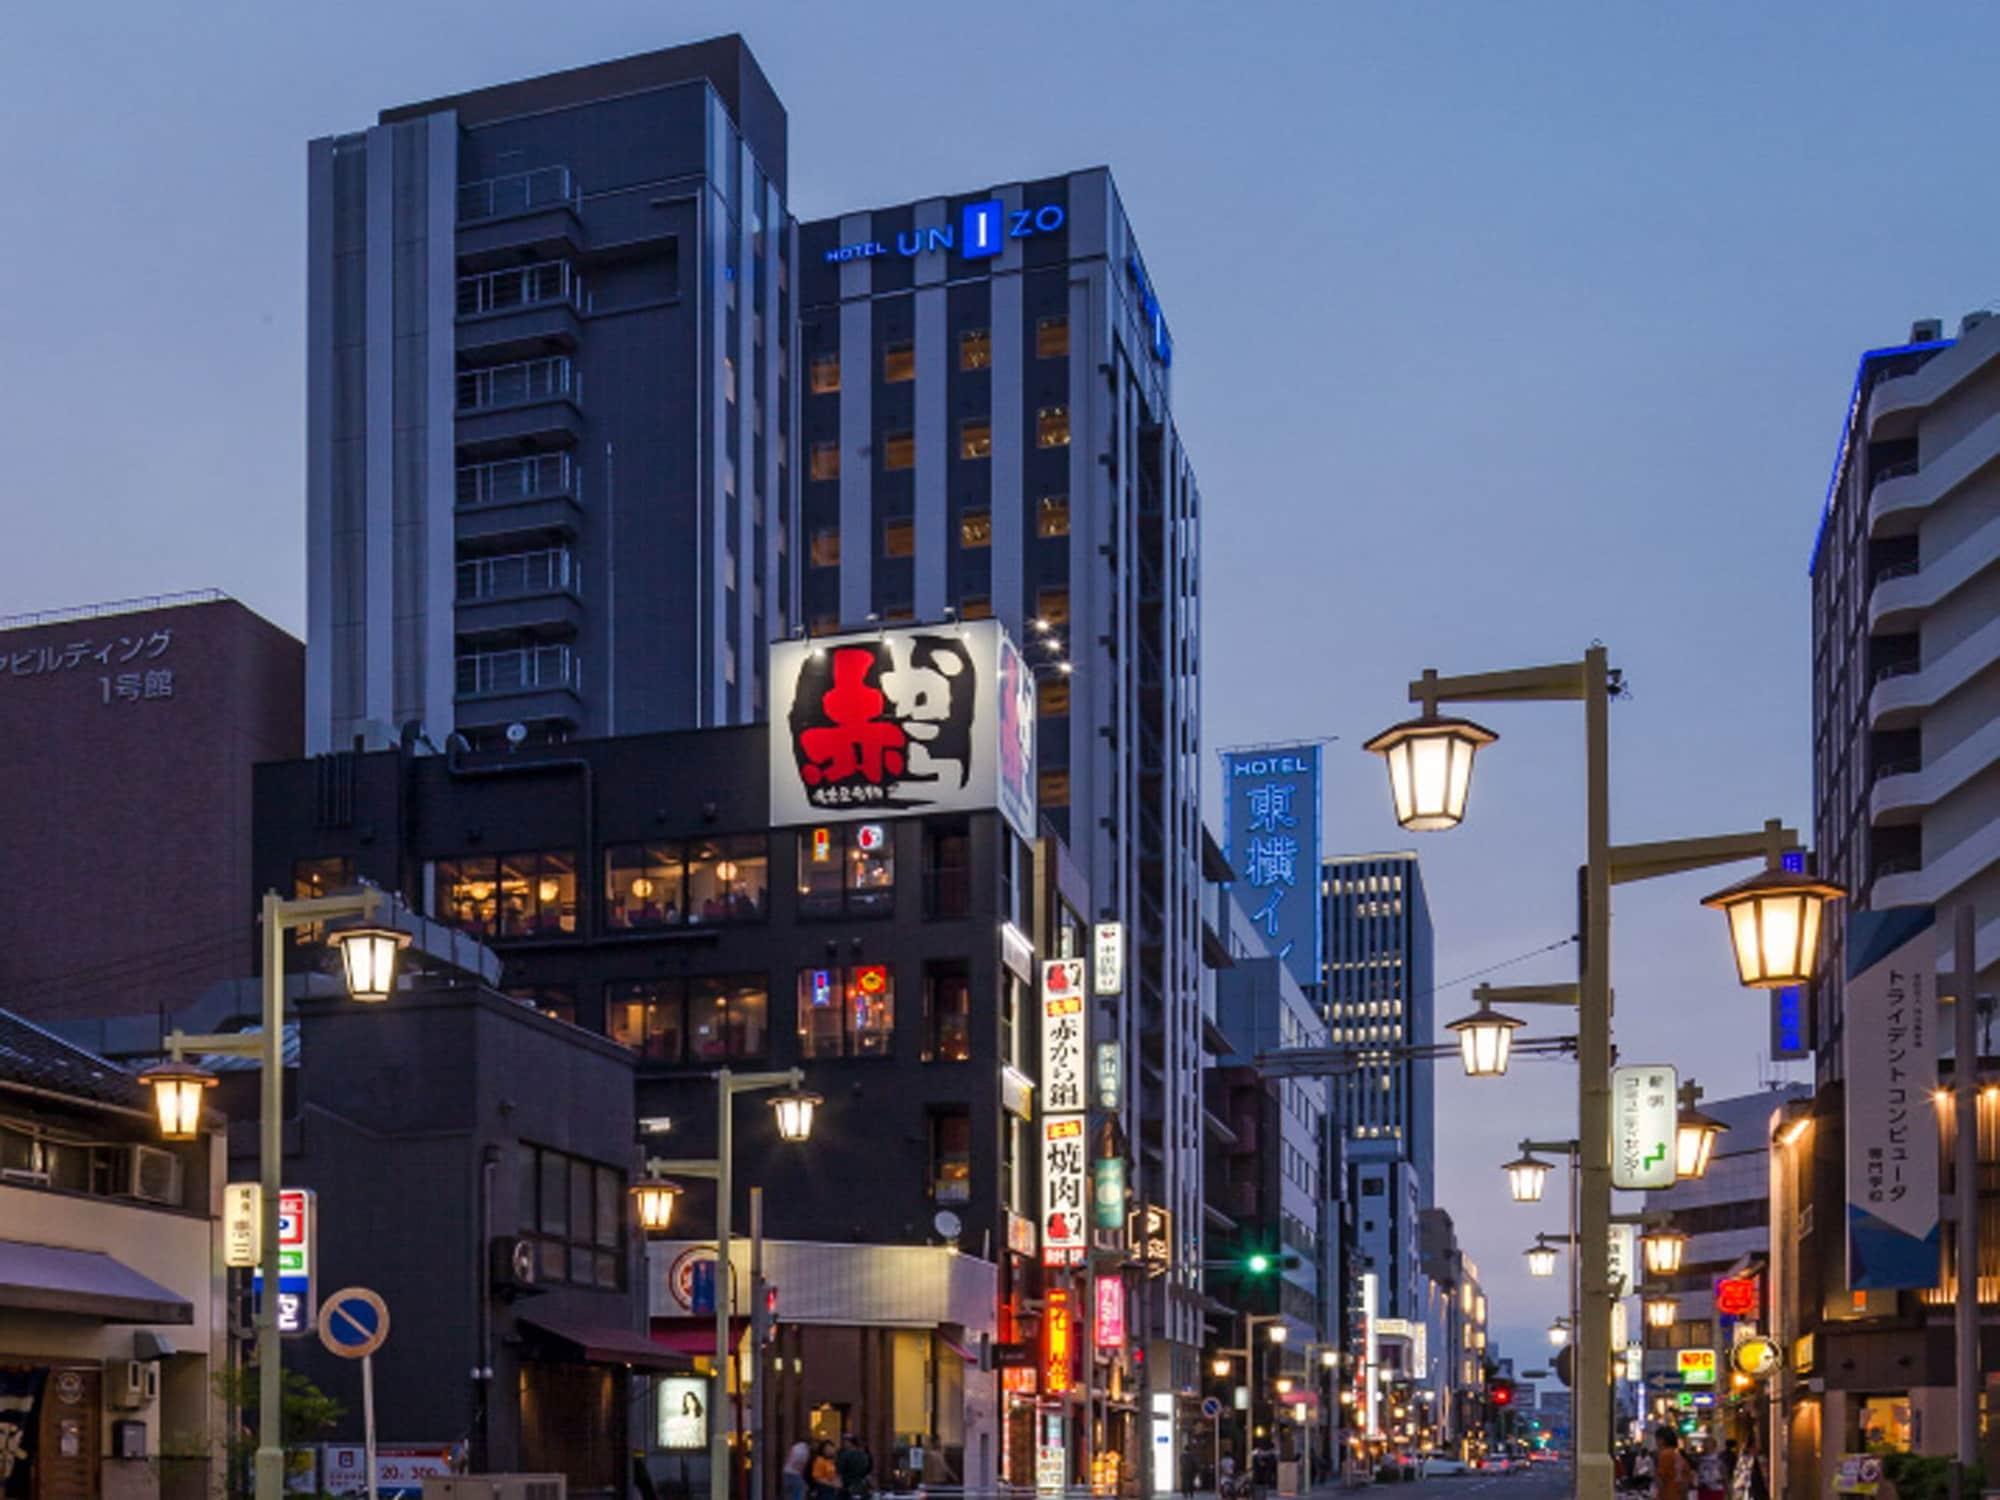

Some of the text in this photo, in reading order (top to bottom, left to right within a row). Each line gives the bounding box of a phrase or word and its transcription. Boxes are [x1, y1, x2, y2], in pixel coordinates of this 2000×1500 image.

[825, 200, 1065, 264] HOTEL UNIZO
[99, 670, 173, 704] 1号館
[1234, 757, 1310, 776] HOTEL
[1050, 1018, 1079, 1107] 赤から鍋
[1887, 969, 1908, 1203] トライデントコンピュータ
[1048, 1143, 1082, 1209] 焼肉
